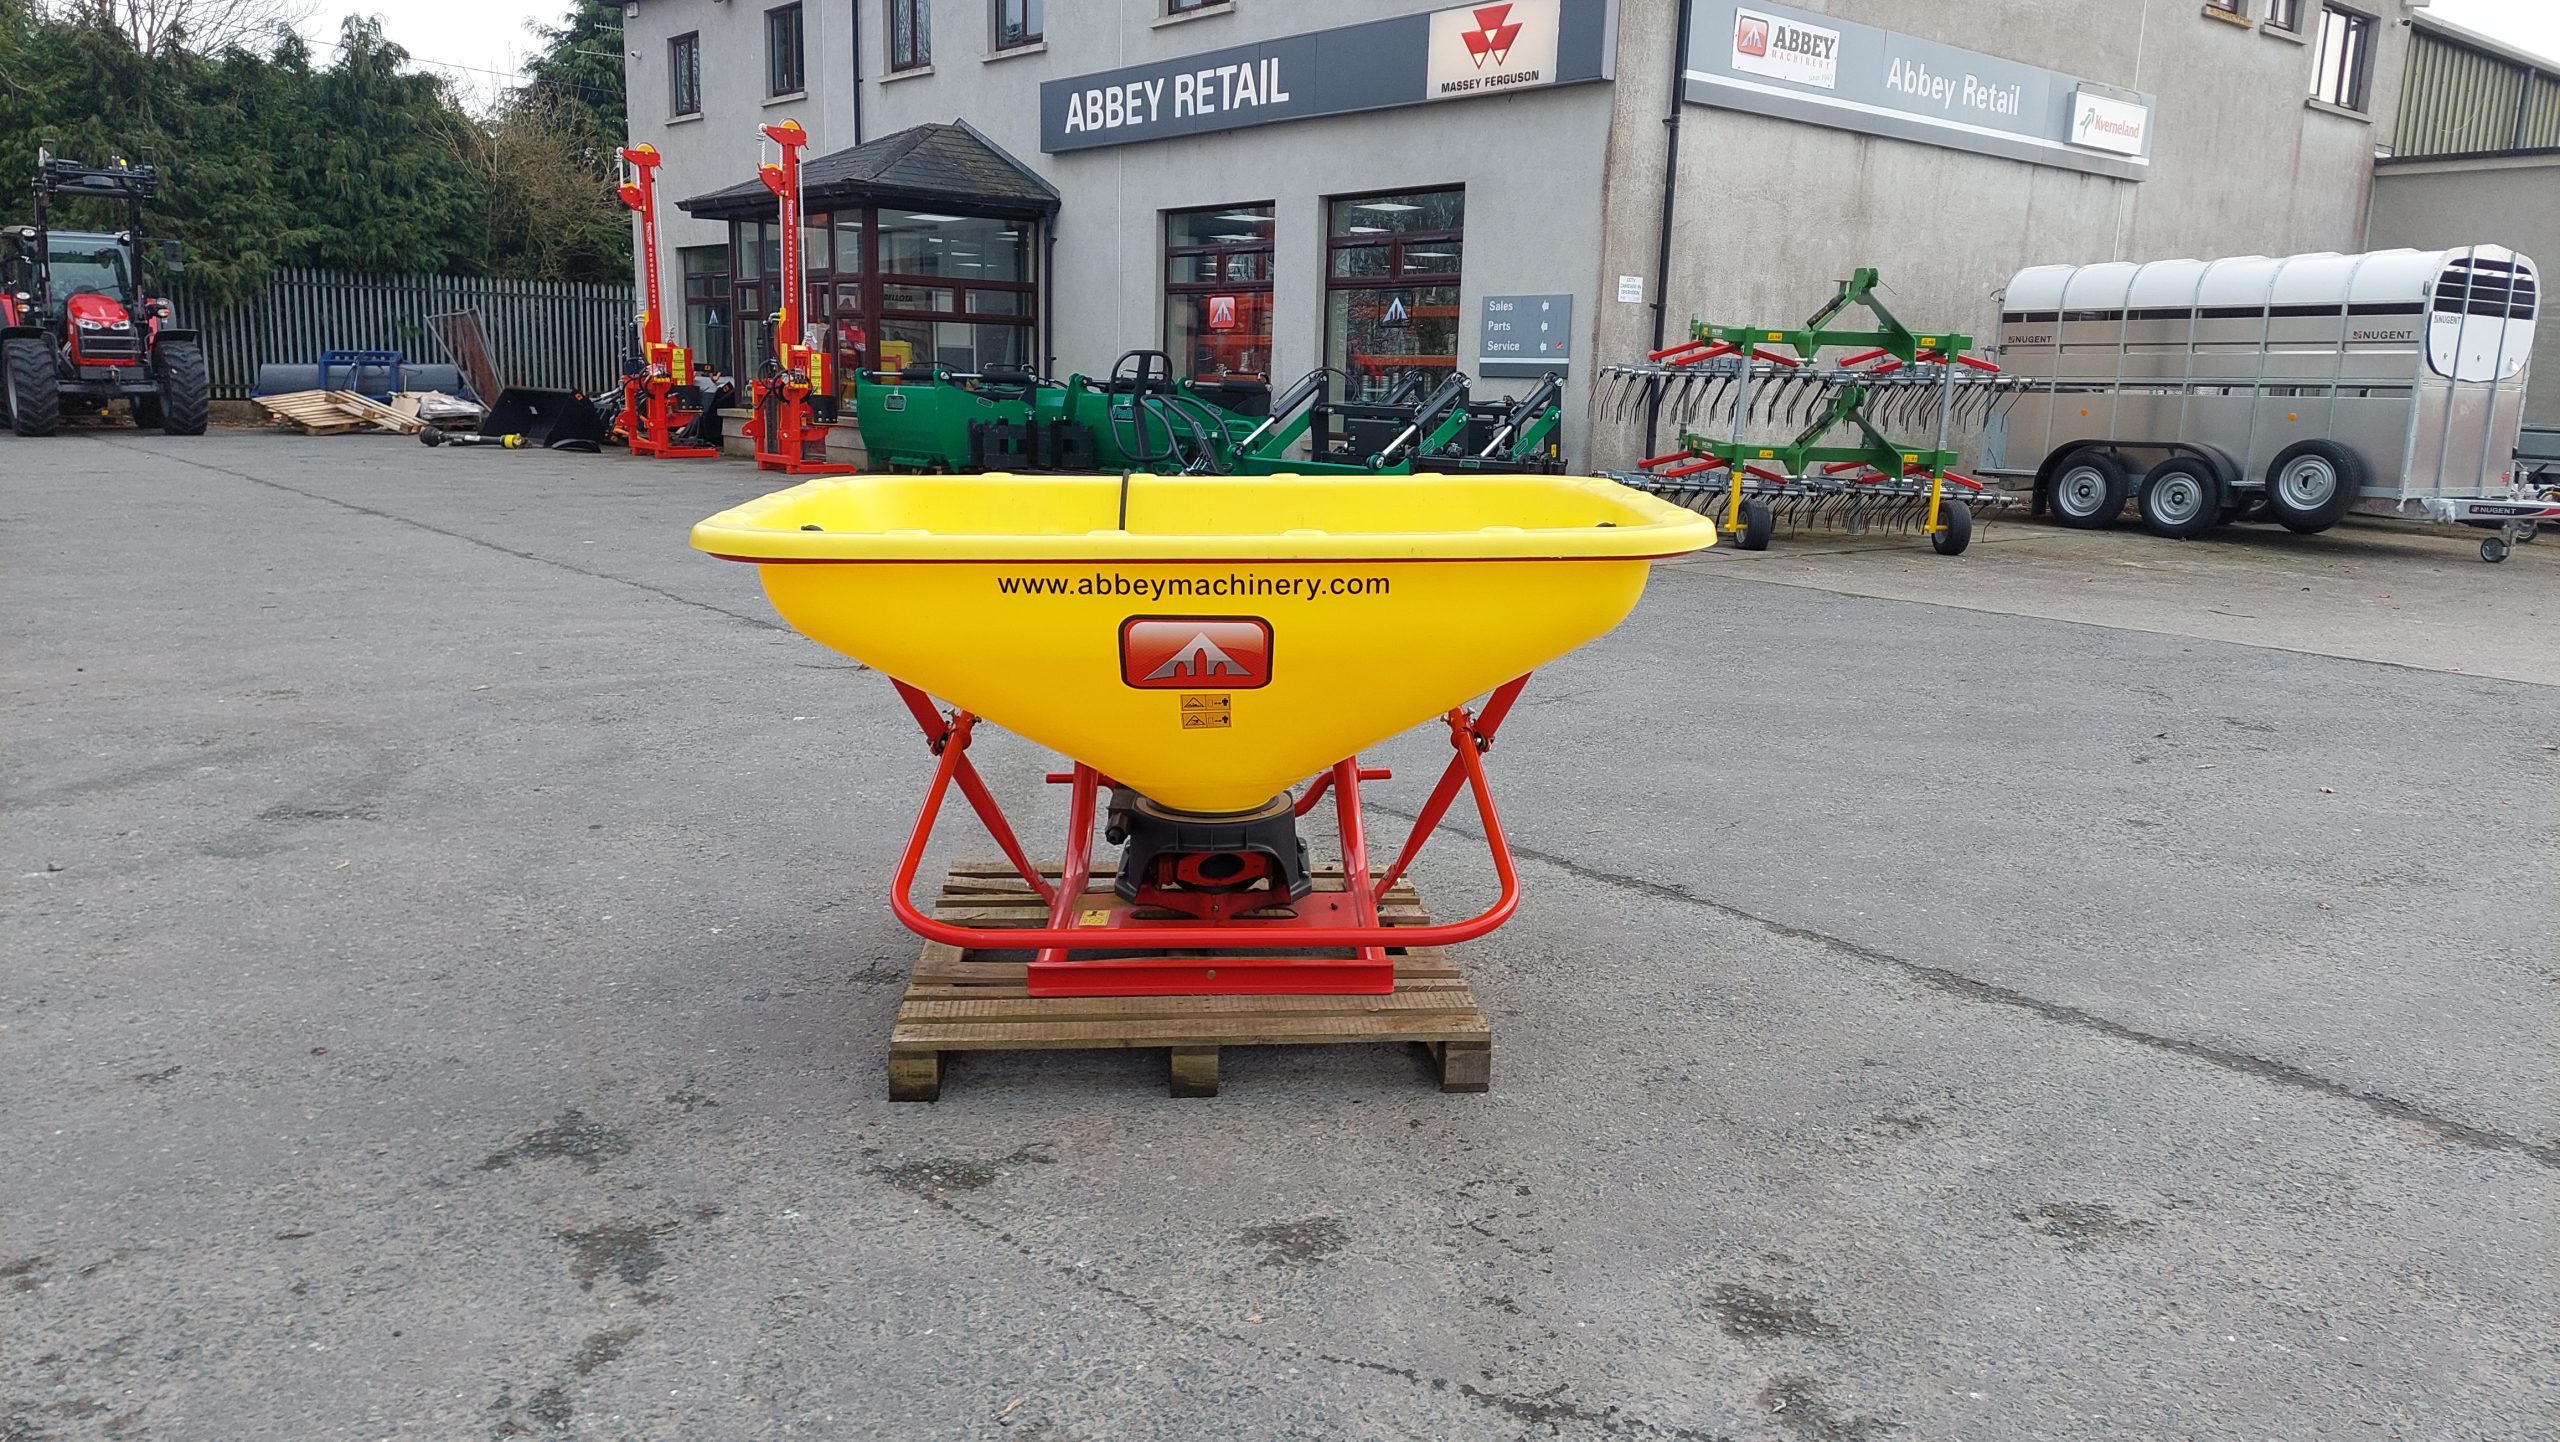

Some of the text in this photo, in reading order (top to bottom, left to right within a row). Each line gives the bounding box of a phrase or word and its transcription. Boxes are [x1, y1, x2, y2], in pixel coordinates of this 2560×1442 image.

[1772, 25, 1835, 60] ABBEY
[1771, 49, 1830, 71] MACHINERY
[1441, 70, 1539, 93] MASSEY FERGUSON
[1886, 57, 2020, 115] Abbey Retail
[1065, 57, 1290, 134] ABBEY RETAIL
[2095, 114, 2140, 138] Kverneland
[1489, 300, 1513, 311] Sales
[1488, 320, 1511, 331] Parts
[2440, 315, 2461, 325] NUGENT
[2015, 335, 2053, 343] NUGENT
[2363, 330, 2413, 340] NUGENT
[1487, 340, 1520, 351] Service
[2480, 506, 2517, 515] NUGENT
[997, 573, 1391, 601] www.abbeymachinery.com
